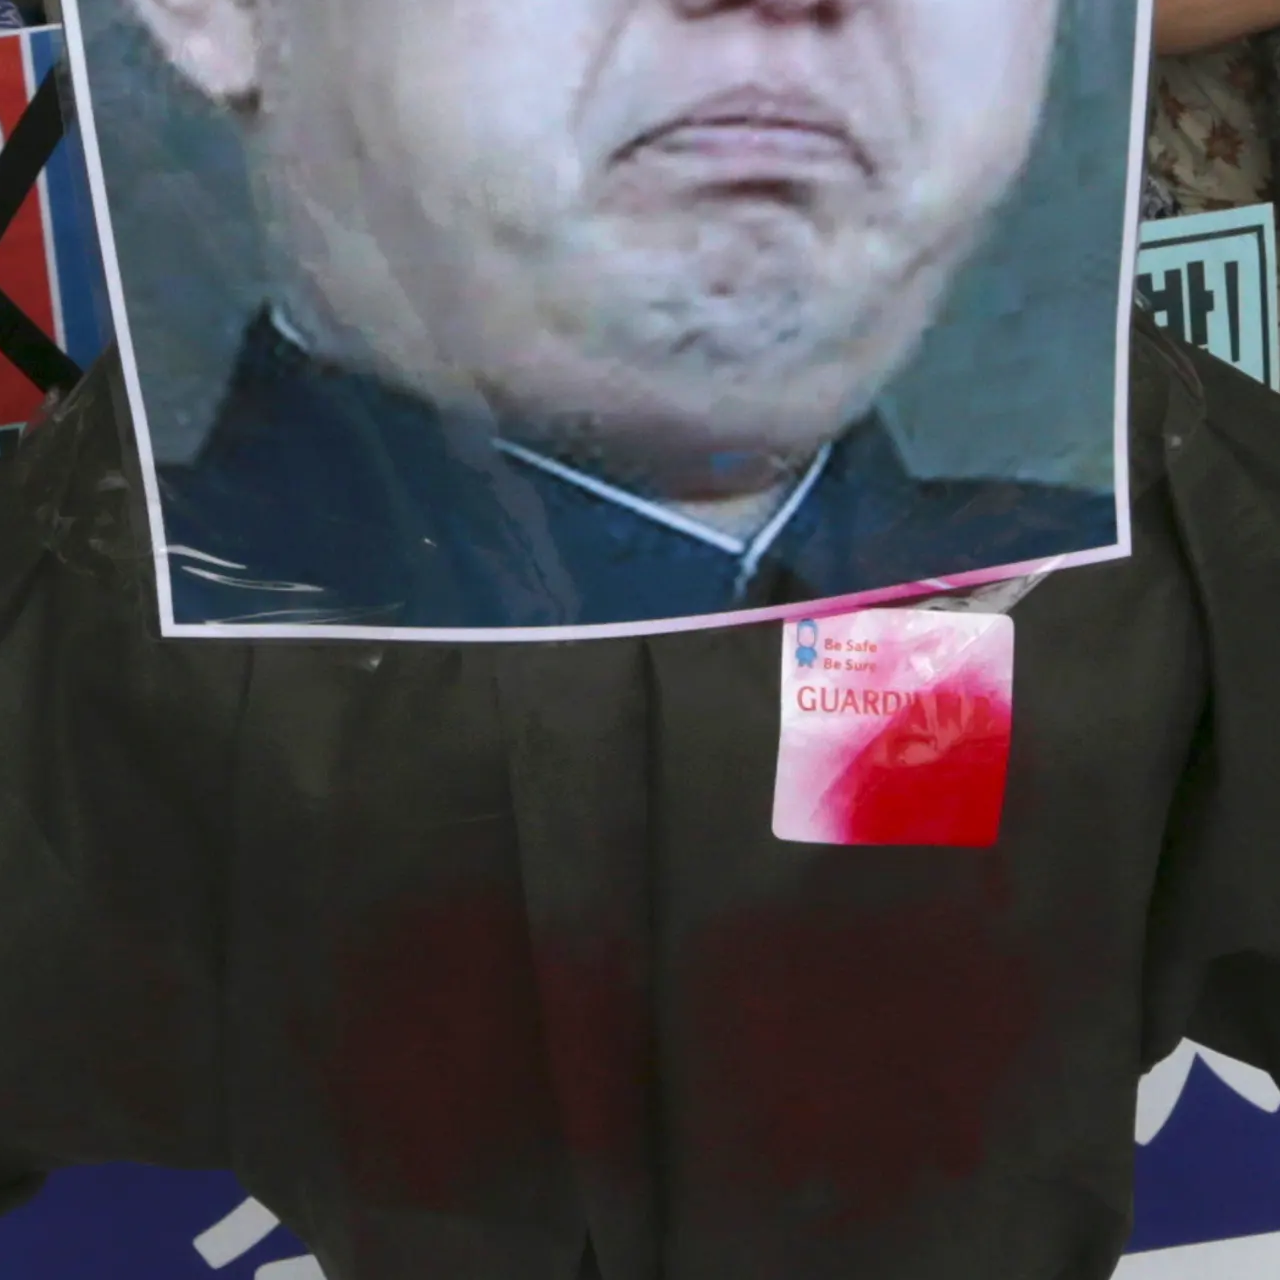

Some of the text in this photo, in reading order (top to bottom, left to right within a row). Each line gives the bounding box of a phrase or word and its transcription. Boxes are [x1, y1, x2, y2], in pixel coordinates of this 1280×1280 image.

[824, 638, 878, 654] Be Safe
[823, 657, 877, 672] Be Sure
